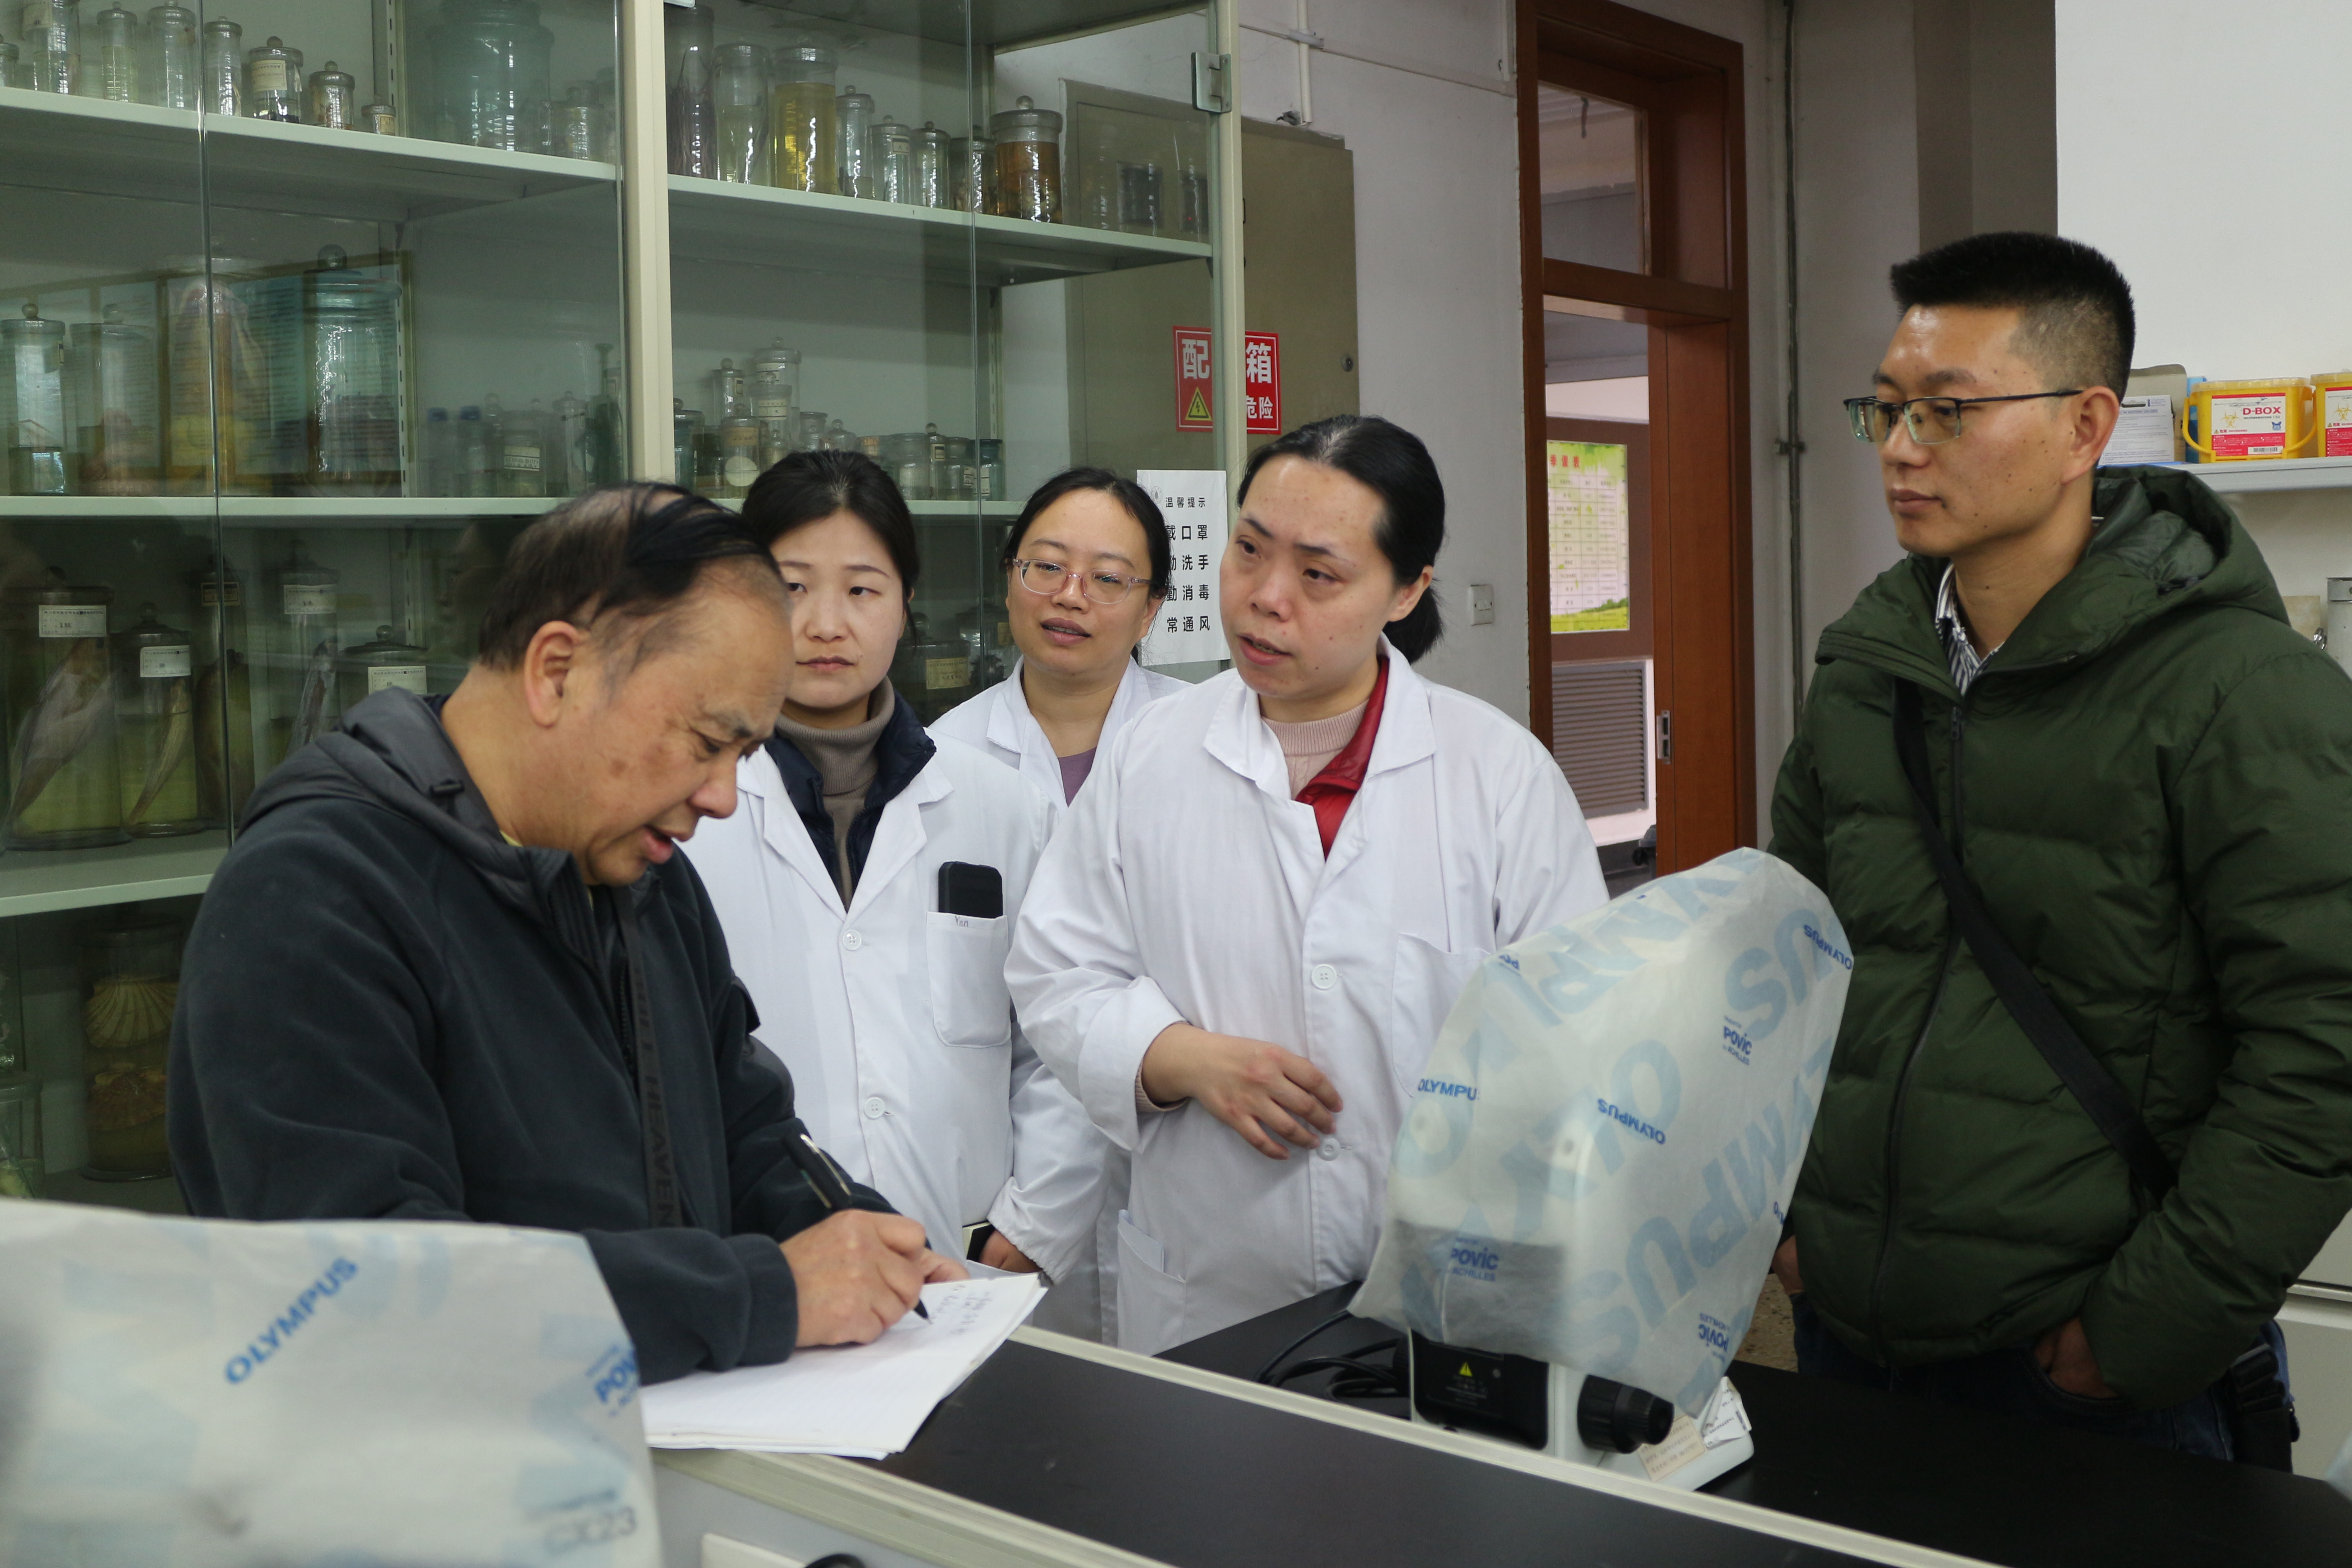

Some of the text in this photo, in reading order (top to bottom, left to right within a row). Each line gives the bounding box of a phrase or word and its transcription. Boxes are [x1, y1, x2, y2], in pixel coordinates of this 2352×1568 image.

[1182, 338, 1272, 384] 配箱
[2243, 407, 2281, 415] D-BOX
[1166, 497, 1205, 508] 温馨提示
[1166, 524, 1208, 540] 戴口罩
[1166, 584, 1209, 601] 勤消毒
[1167, 616, 1210, 633] 常通风
[1803, 924, 1852, 970] OLYMPUS
[1418, 1078, 1480, 1101] OLYMPU
[1597, 1098, 1666, 1145] OLYMPUS
[645, 1076, 675, 1227] HEAVEN
[224, 1257, 359, 1385] OLYMPUS
[593, 1348, 636, 1404] POV
